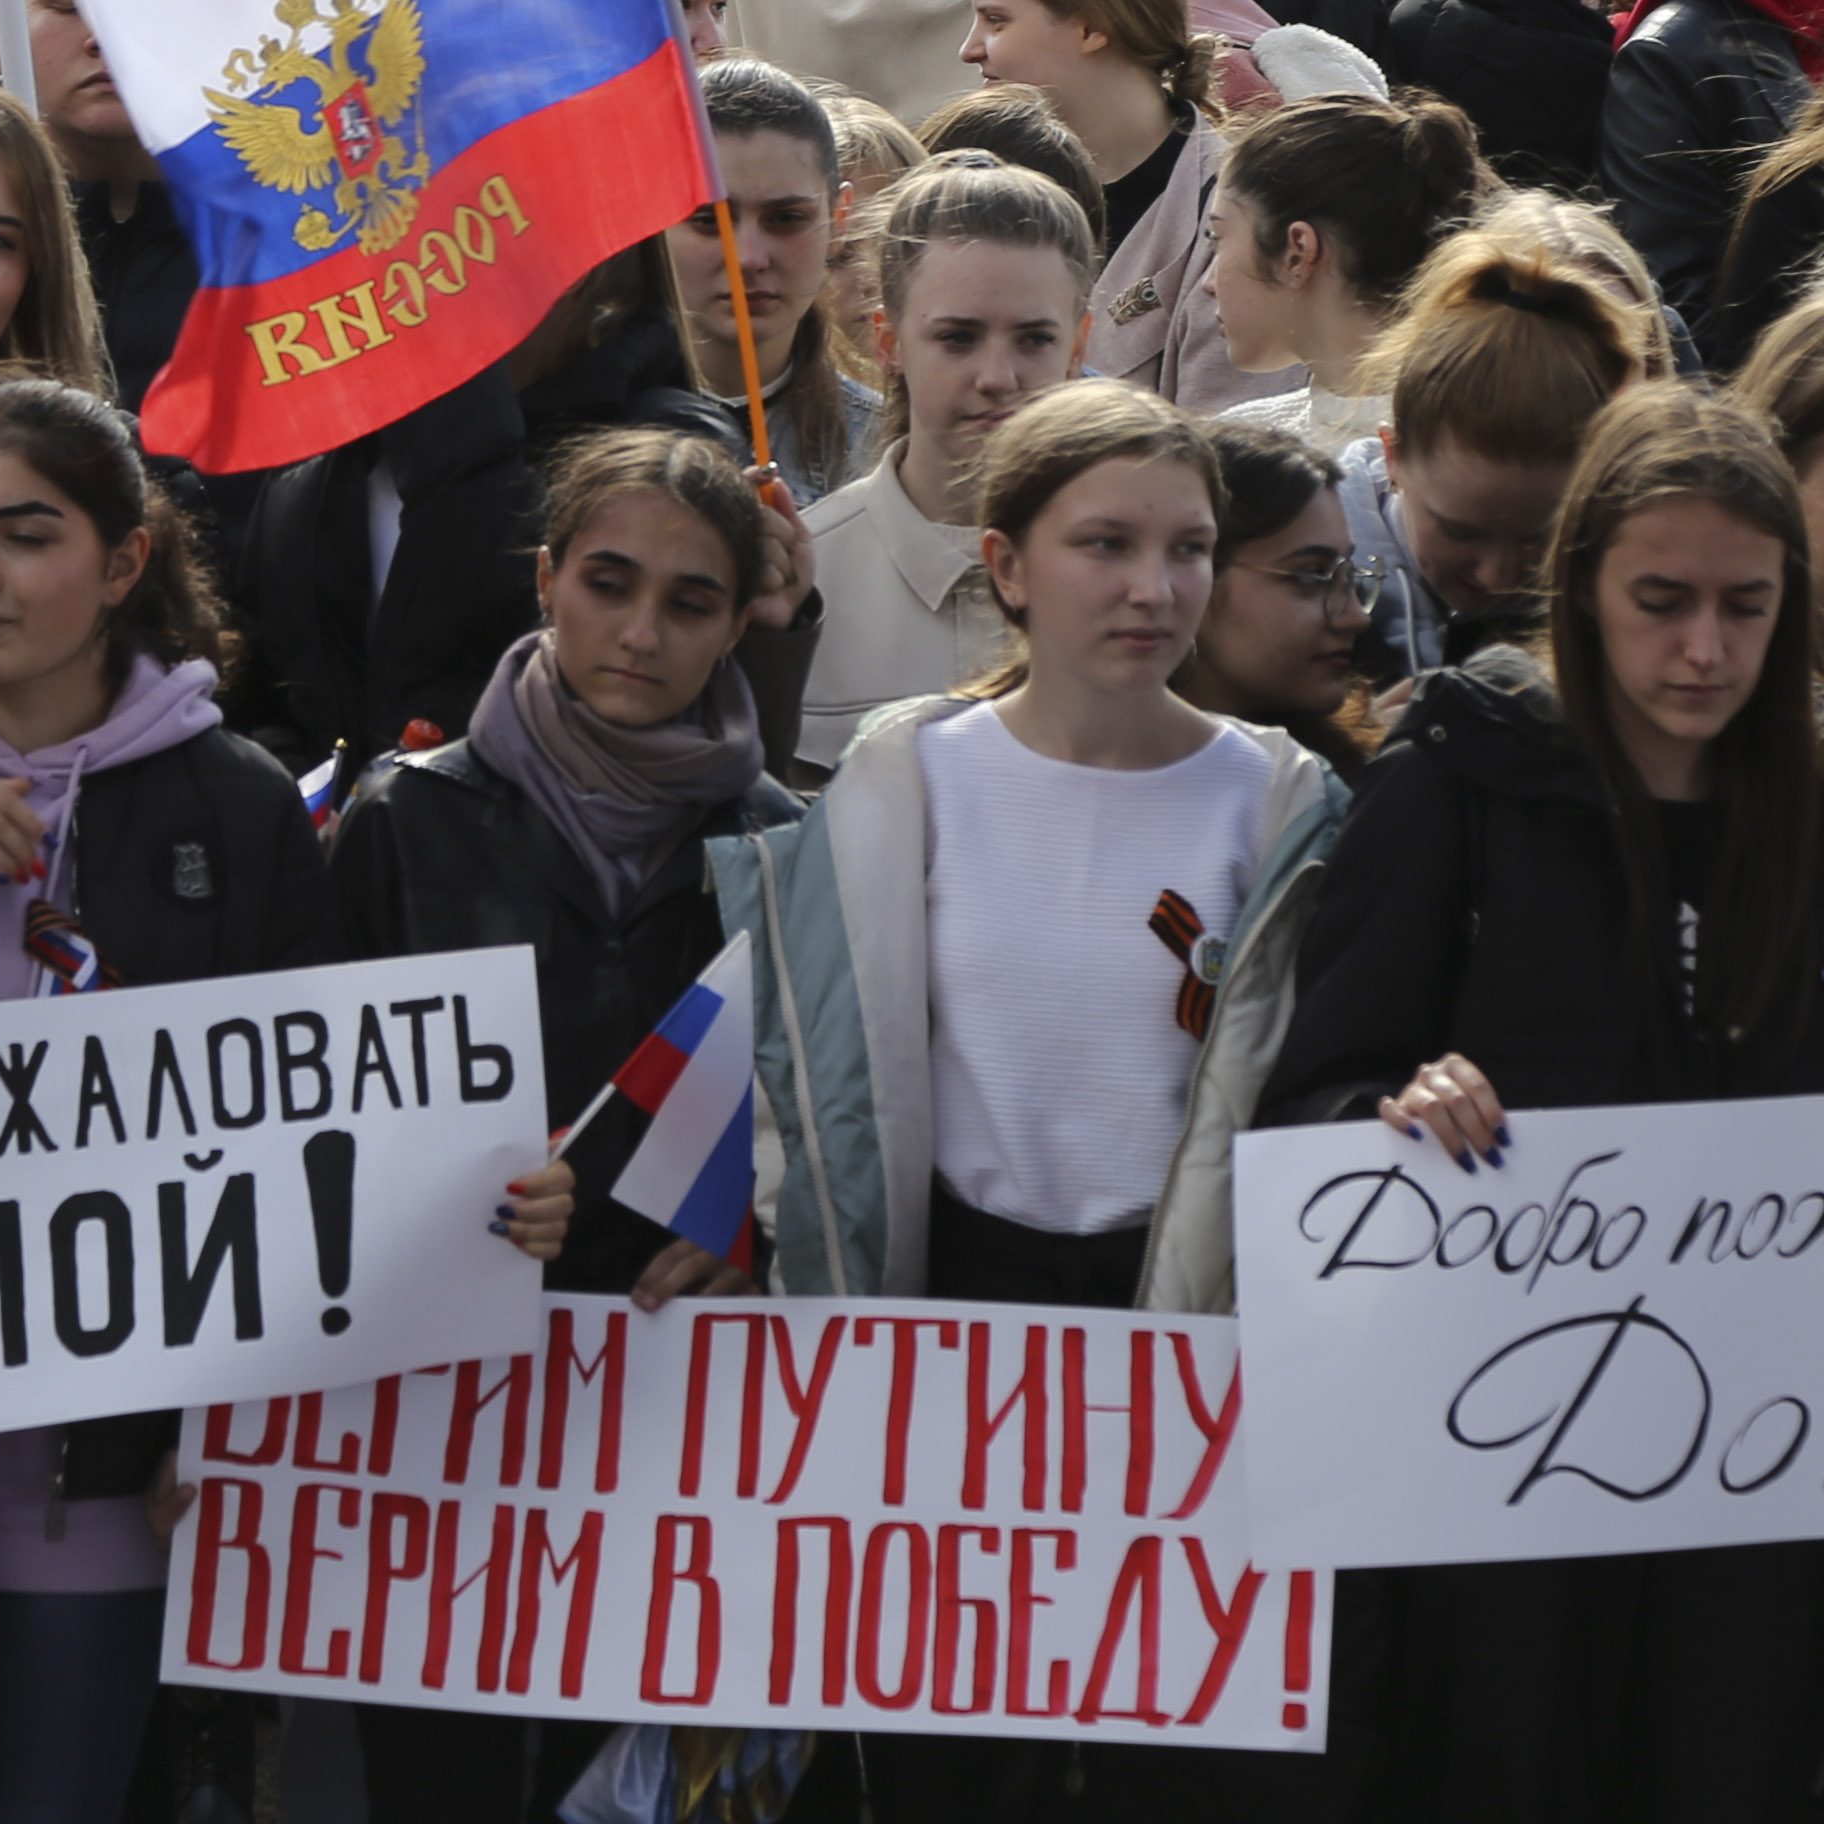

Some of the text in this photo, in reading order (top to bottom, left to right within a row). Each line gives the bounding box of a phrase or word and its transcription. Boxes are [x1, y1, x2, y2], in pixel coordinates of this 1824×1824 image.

[1300, 1149, 1649, 1294] Добро
[679, 1313, 1243, 1520] ПУТИНУ
[186, 1477, 1316, 1731] ВЕРИМ В ПОБЕДУ!
